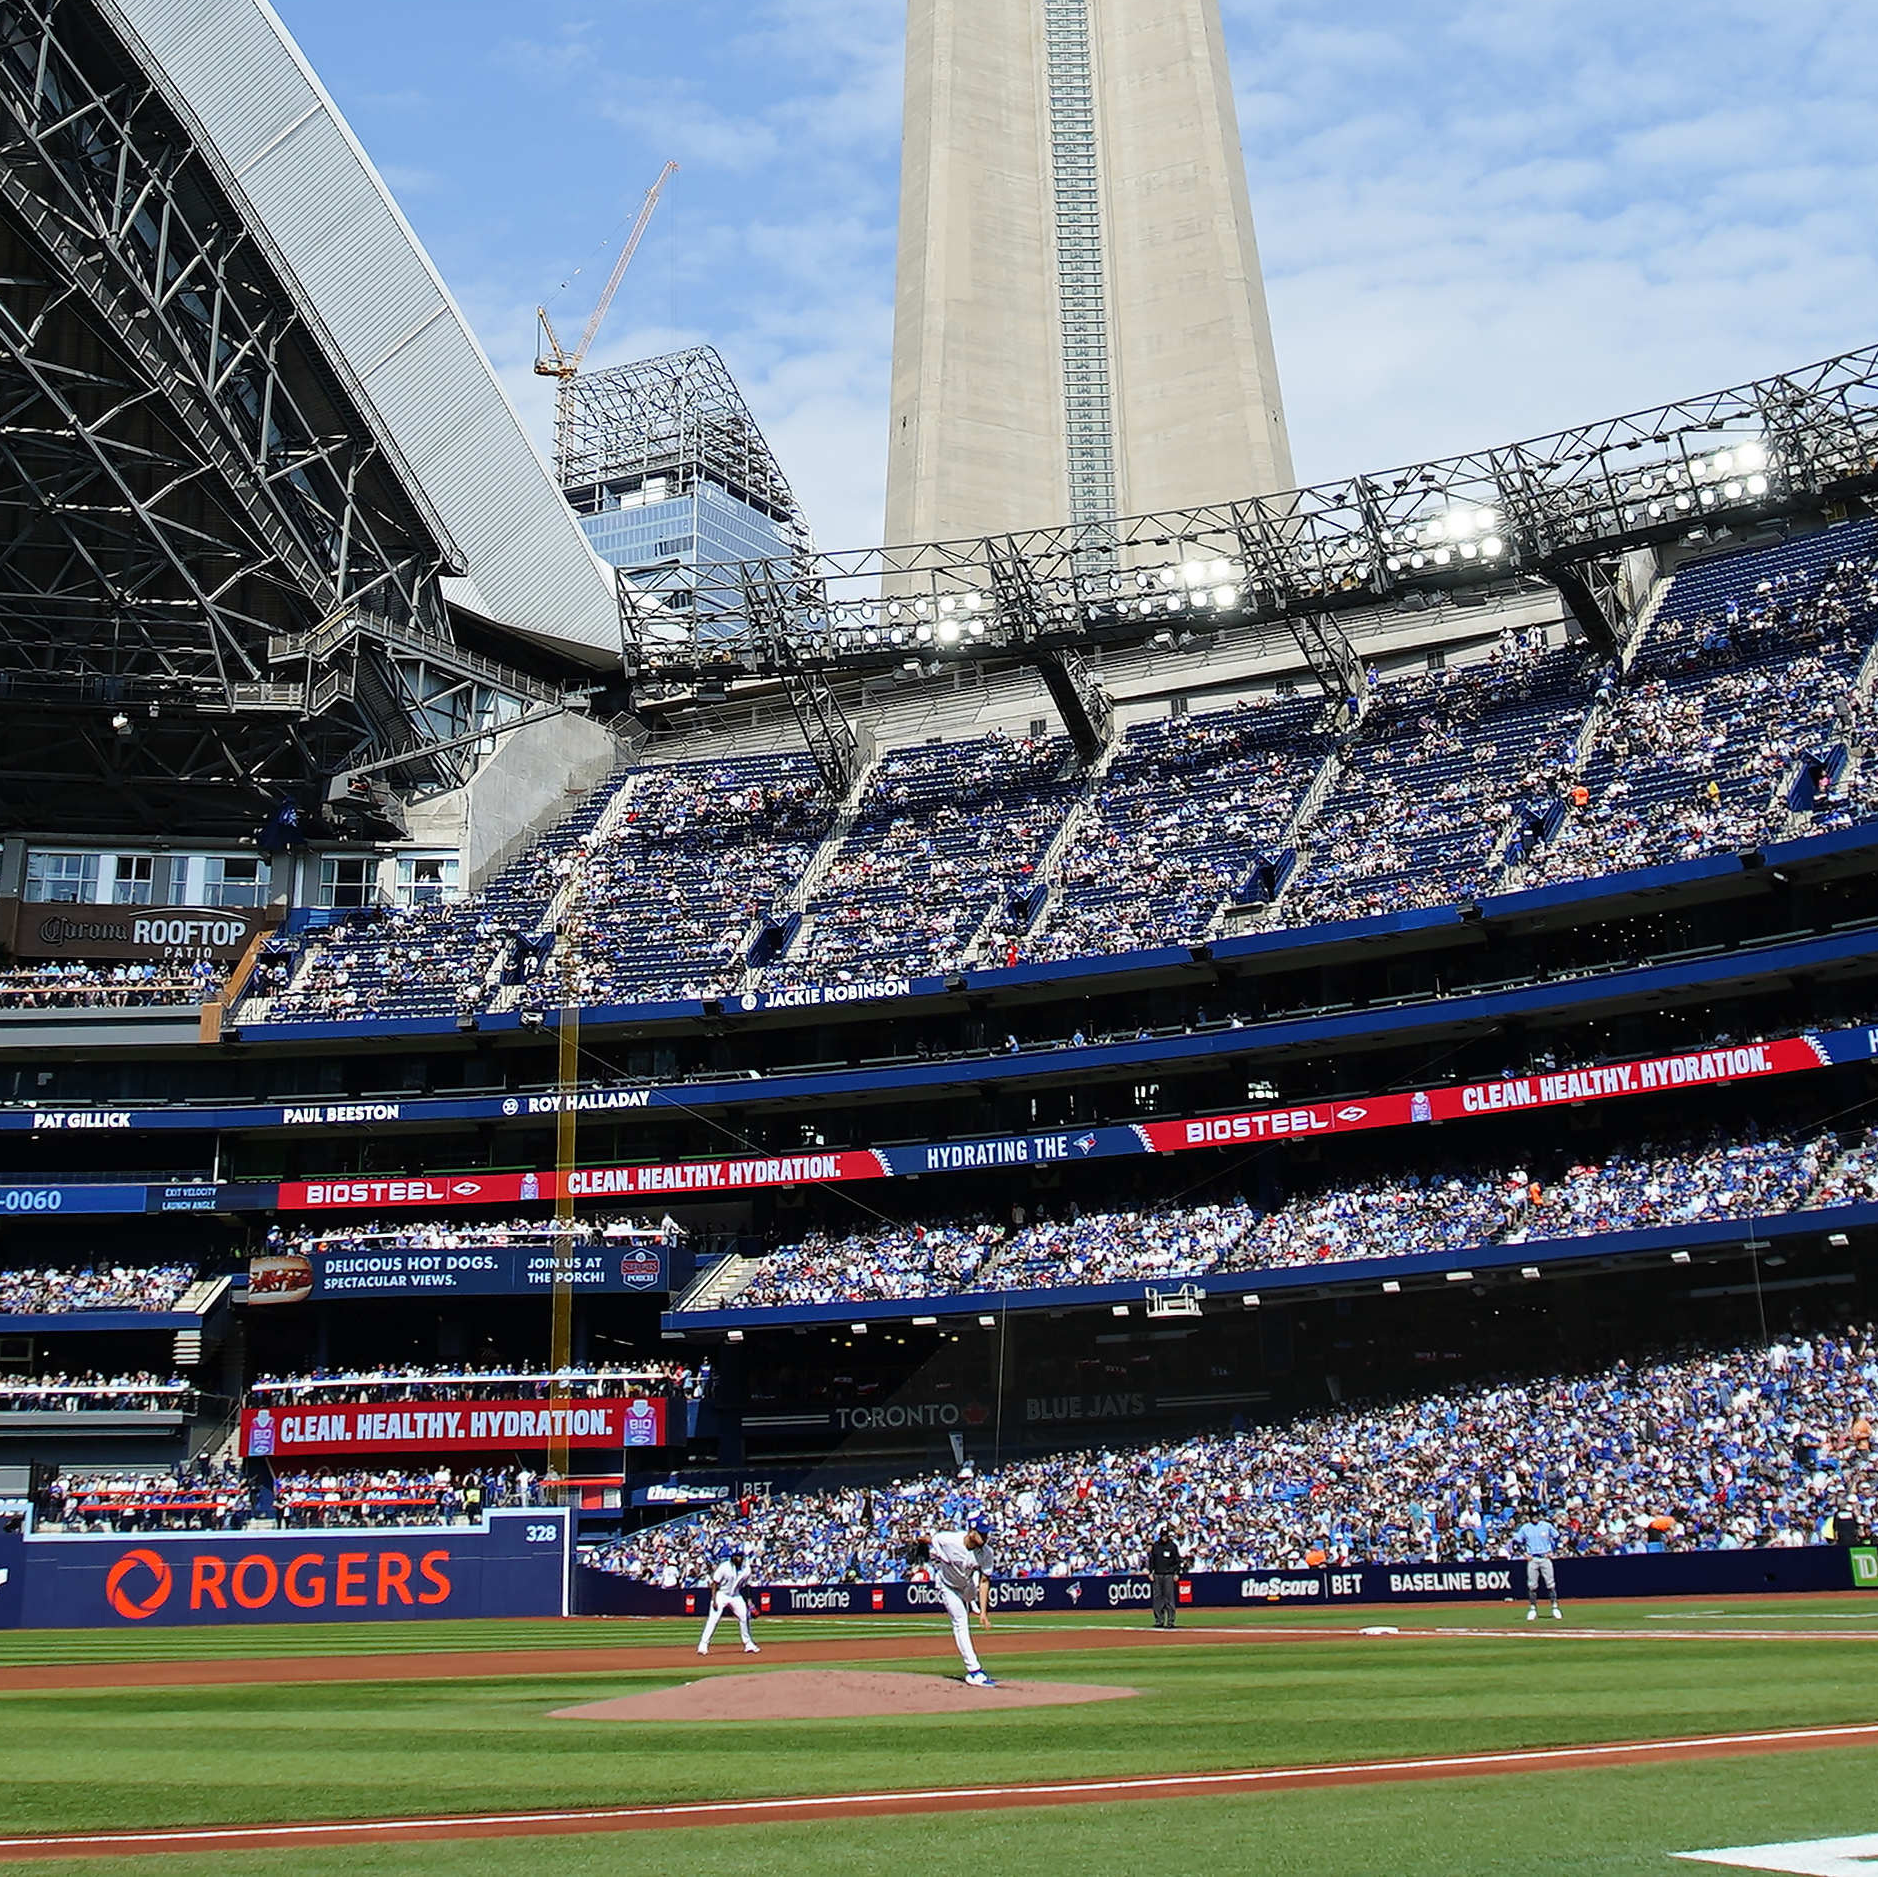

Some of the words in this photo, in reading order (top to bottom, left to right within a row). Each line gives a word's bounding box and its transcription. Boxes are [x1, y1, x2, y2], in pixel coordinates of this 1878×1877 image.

[40, 916, 129, 948] Corona
[133, 919, 246, 948] ROOFTOP
[163, 947, 212, 959] PATIO
[764, 988, 820, 1008] JACKIE
[824, 980, 910, 1003] ROBINSON
[1463, 1083, 1538, 1113] CLEAN.
[1540, 1066, 1638, 1102] HEALTHY.
[528, 1097, 561, 1113] ROY
[565, 1091, 650, 1112] HALLADAY
[33, 1113, 66, 1129] PAT
[68, 1113, 131, 1129] GILLICK
[283, 1107, 322, 1124] PAUL
[325, 1105, 400, 1122] BEESTON
[1186, 1110, 1329, 1144] BIOSTEEL
[926, 1141, 1029, 1170] HYDRATING
[1034, 1136, 1068, 1159] THE
[568, 1169, 635, 1195] CLEAN.
[637, 1162, 726, 1191] HEALTHY.
[183, 1187, 217, 1197] VELOCITY
[306, 1182, 444, 1204] BIOSTEEL
[325, 1258, 402, 1274] DELICIOUS
[408, 1257, 442, 1272] HOT
[447, 1256, 498, 1271] DOGS.
[527, 1258, 558, 1270] JOIN
[562, 1258, 577, 1270] US
[581, 1257, 603, 1269] AT
[324, 1276, 408, 1290] SPECTACULAR
[411, 1274, 457, 1288] VIEWS.
[528, 1272, 552, 1284] THE
[555, 1271, 605, 1284] PORCH!
[836, 1404, 959, 1430] TORONTO
[1027, 1397, 1083, 1420] BLUE
[1088, 1393, 1146, 1418] JAYS
[280, 1415, 352, 1443] CLEAN.
[356, 1412, 466, 1440] HEALTHY.
[647, 1485, 729, 1503] theScore
[743, 1482, 773, 1496] BET
[525, 1524, 558, 1545] 328
[1853, 1554, 1878, 1579] TD
[189, 1550, 453, 1611] ROGERS
[1241, 1577, 1319, 1598] theScore
[1332, 1574, 1363, 1595] BET
[1390, 1572, 1472, 1592] BASELINE
[1476, 1570, 1512, 1590] BOX
[1002, 1582, 1045, 1607] Shingle
[1109, 1581, 1150, 1606] gaf.ca
